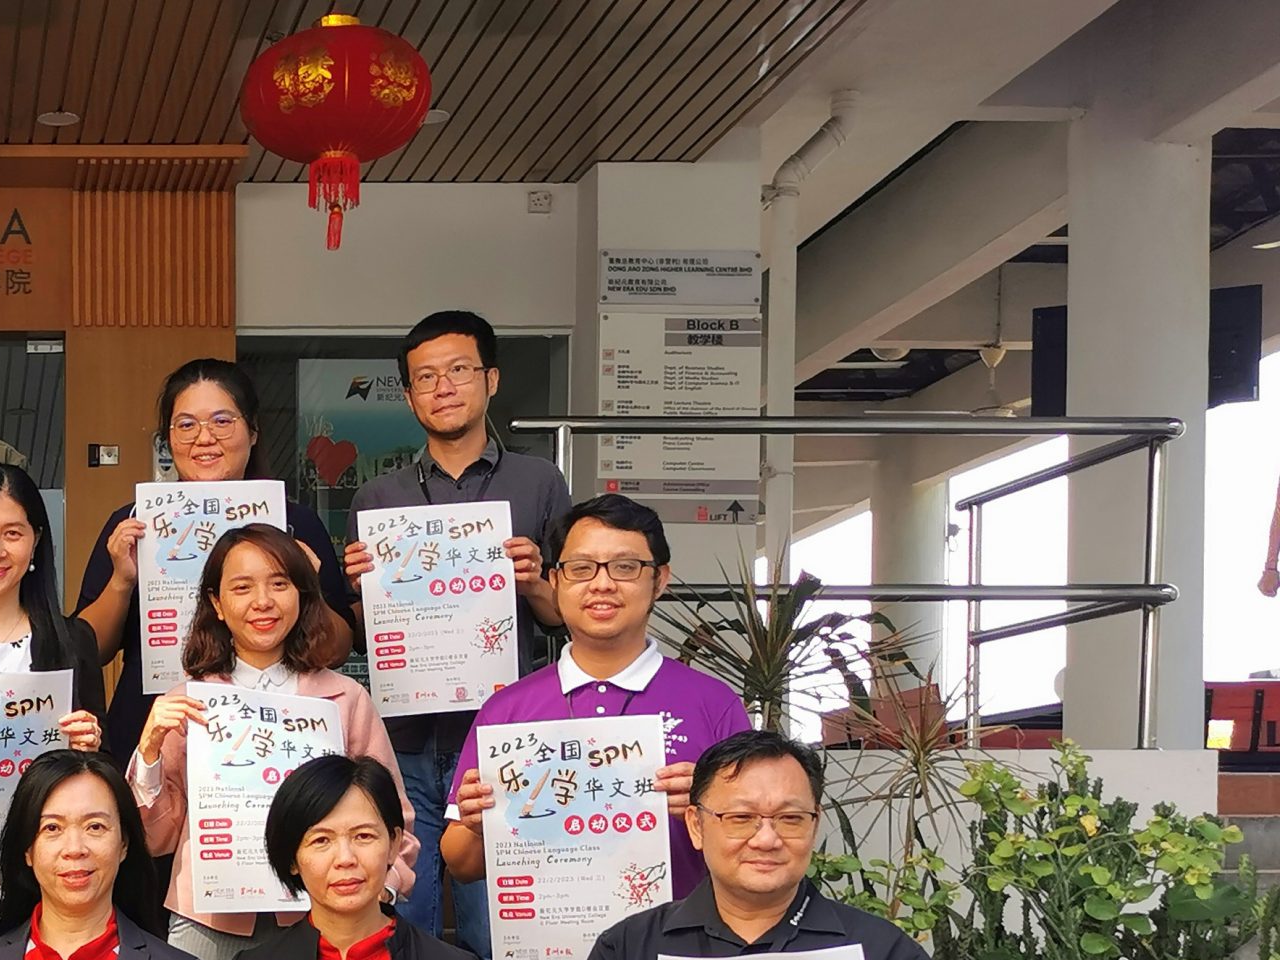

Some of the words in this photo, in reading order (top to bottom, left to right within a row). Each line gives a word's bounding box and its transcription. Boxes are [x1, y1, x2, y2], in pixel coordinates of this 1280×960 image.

[687, 319, 725, 330] Block
[730, 319, 739, 330] B
[145, 491, 185, 509] 2023
[182, 498, 219, 515] 全国
[226, 501, 269, 520] SPM
[368, 515, 408, 536] 2023
[404, 520, 443, 537] 全国
[449, 518, 494, 540] SPM
[5, 695, 54, 717] SPM
[238, 704, 277, 723] 全国
[283, 718, 327, 732] SPM
[489, 734, 538, 757] 2023
[534, 740, 581, 763] 全国
[588, 741, 642, 767] SPM
